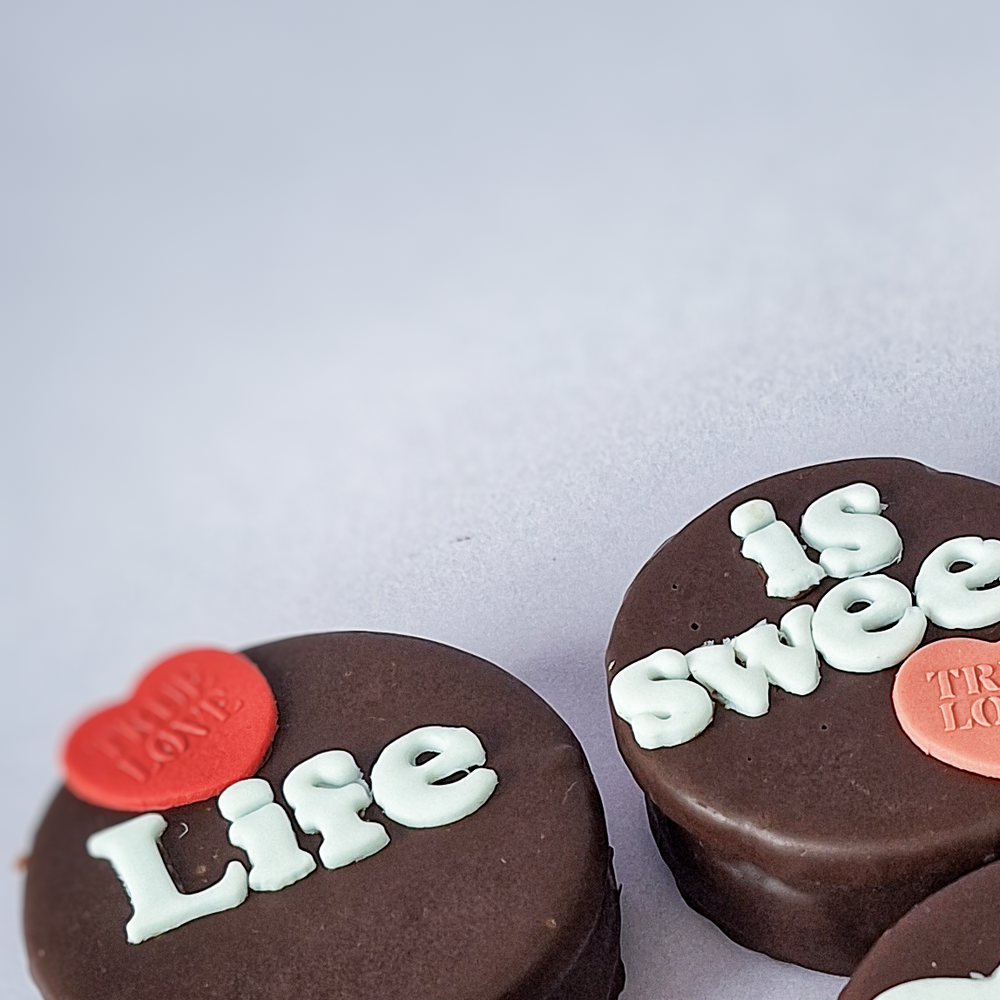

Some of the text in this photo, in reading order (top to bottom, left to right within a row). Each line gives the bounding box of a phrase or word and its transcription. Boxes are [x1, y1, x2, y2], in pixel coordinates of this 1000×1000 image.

[729, 482, 904, 599] is
[112, 686, 246, 784] LOVE
[86, 724, 499, 945] Life
